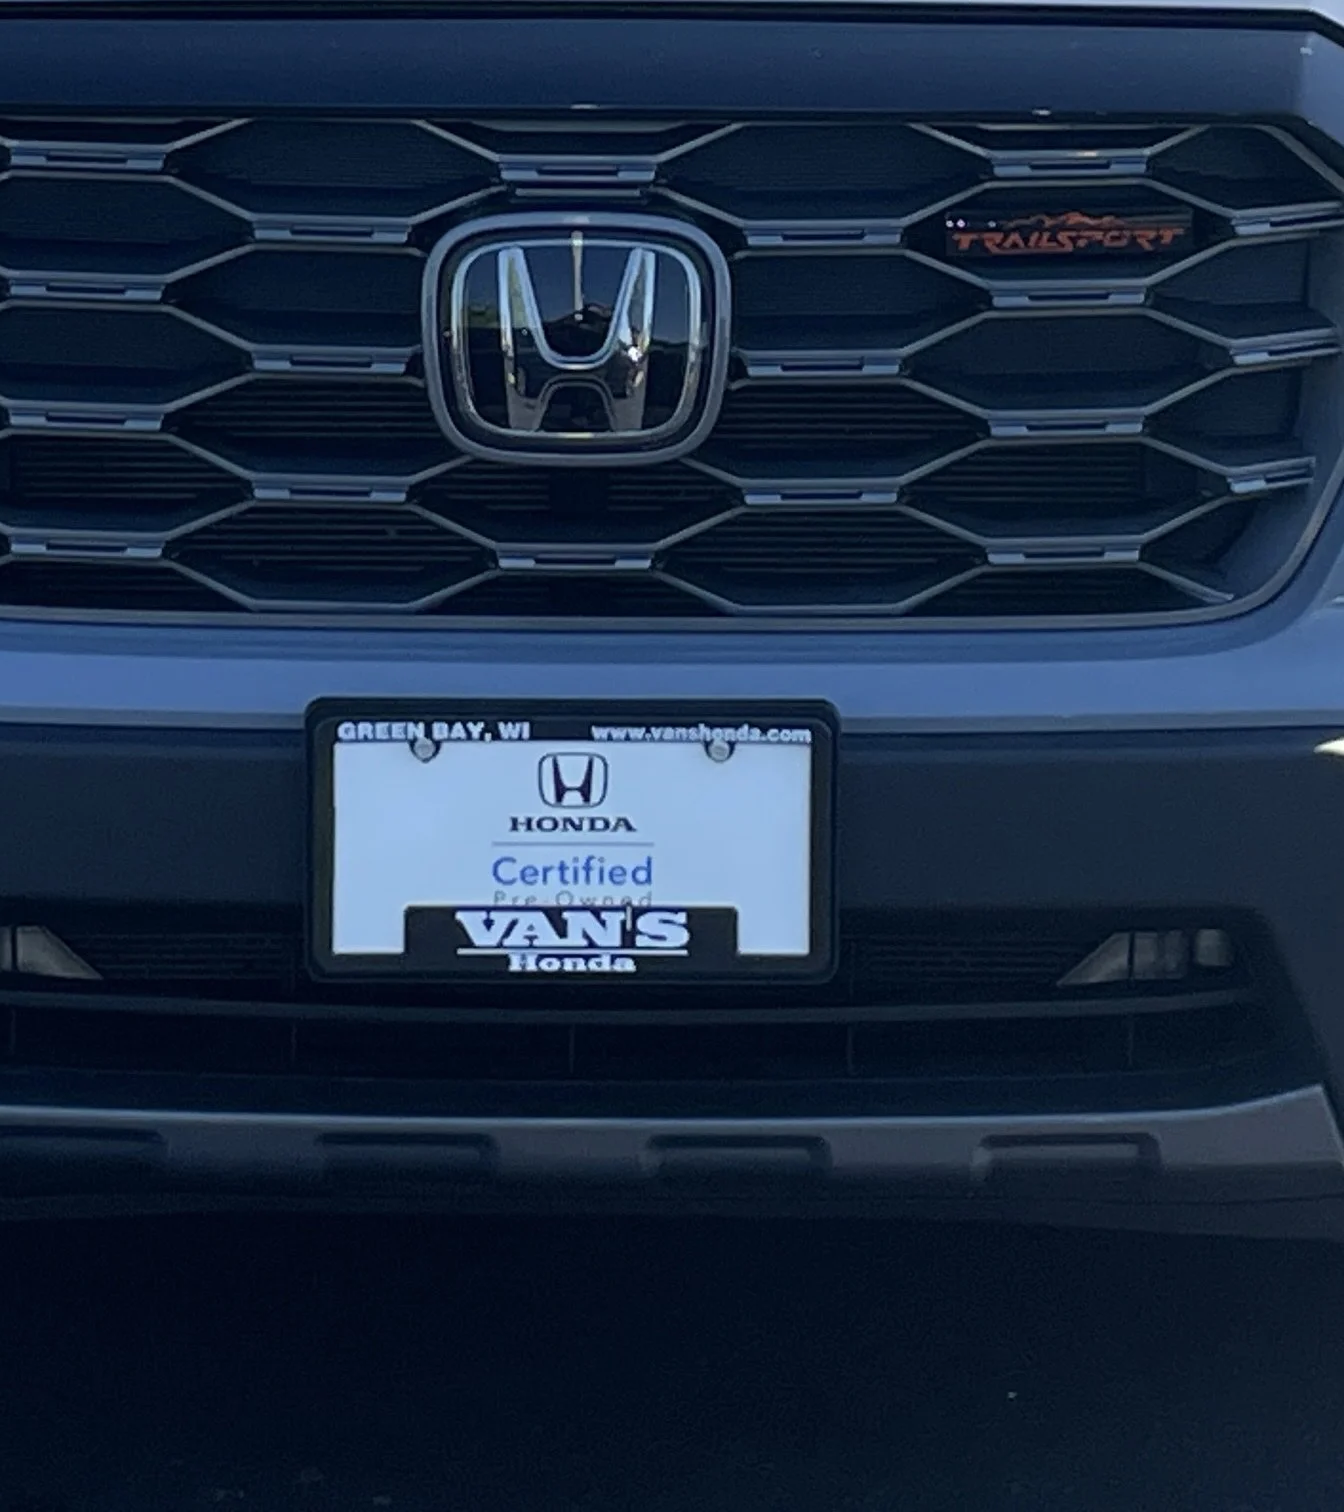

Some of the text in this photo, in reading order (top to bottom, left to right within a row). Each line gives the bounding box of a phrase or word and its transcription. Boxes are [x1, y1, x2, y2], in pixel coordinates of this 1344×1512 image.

[337, 721, 531, 742] GREEN BAY, WI
[591, 723, 812, 743] www.vanshonda.com
[509, 816, 637, 833] HONDA
[492, 855, 653, 886] Certified
[509, 952, 636, 972] Honda
